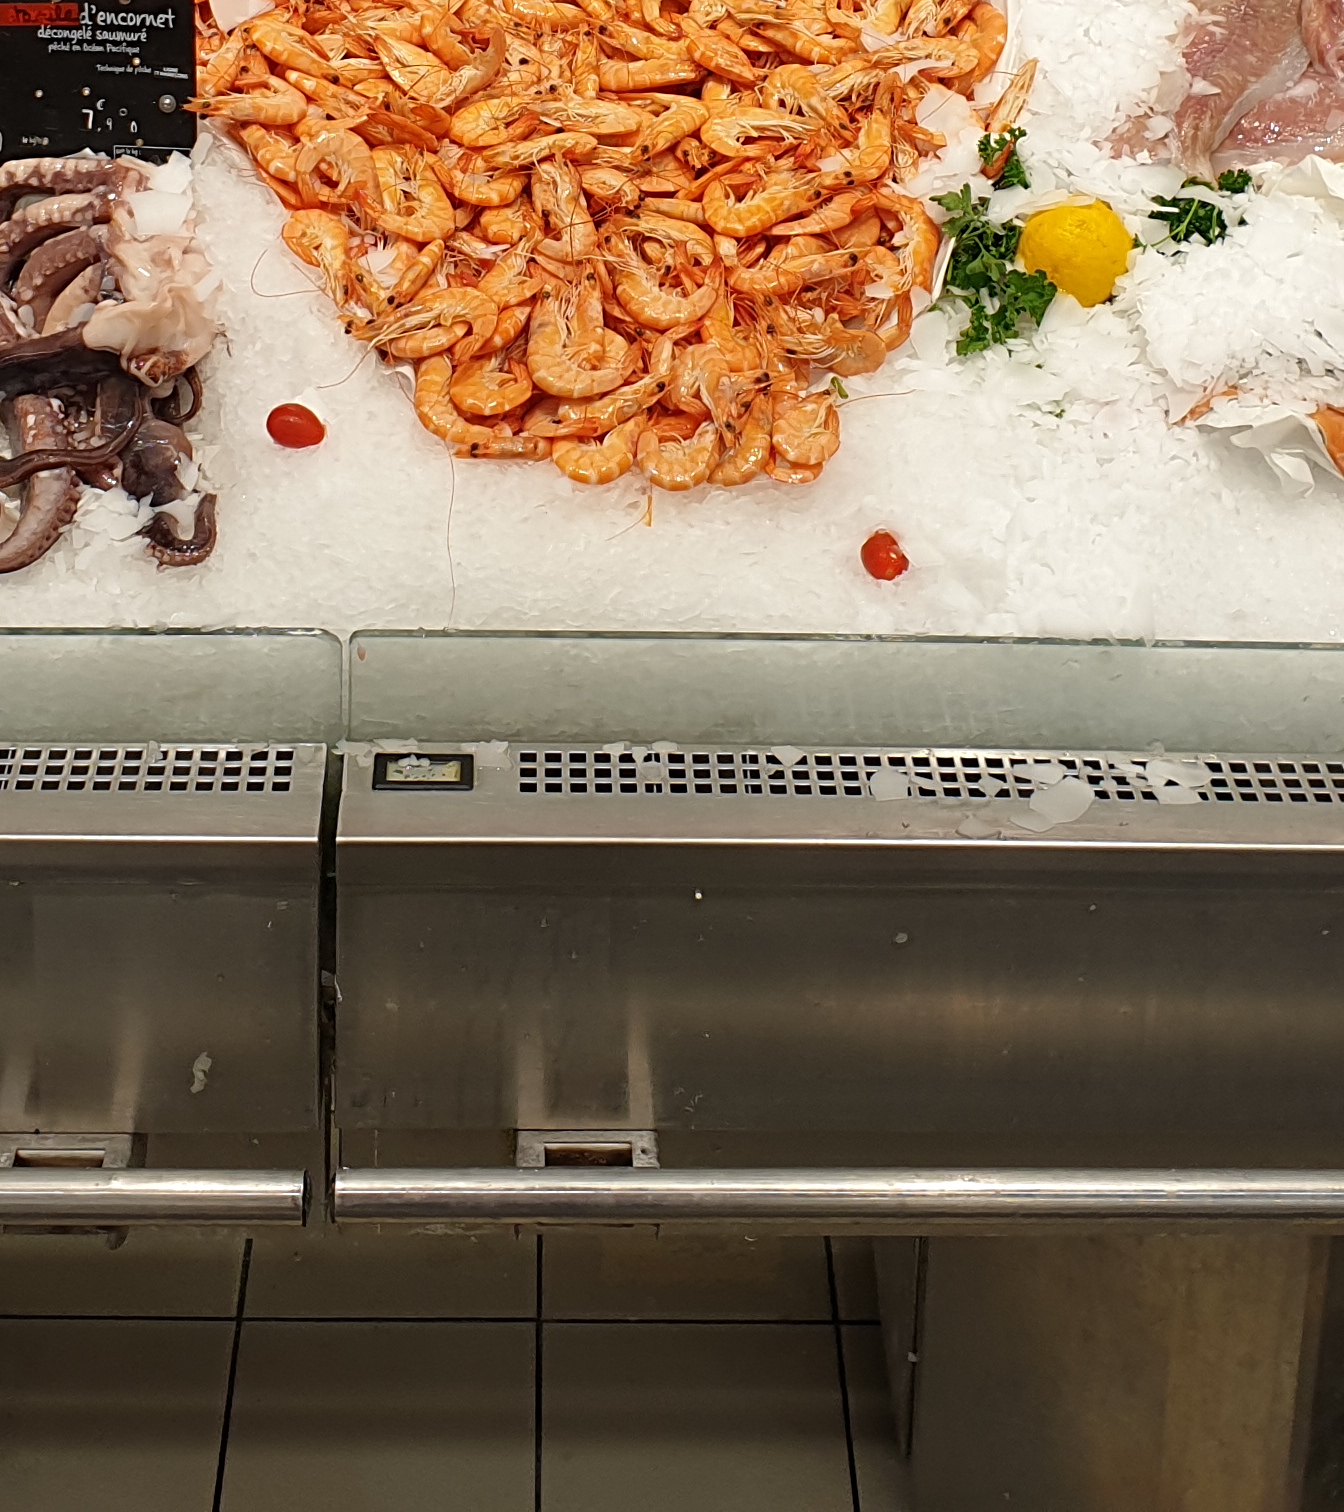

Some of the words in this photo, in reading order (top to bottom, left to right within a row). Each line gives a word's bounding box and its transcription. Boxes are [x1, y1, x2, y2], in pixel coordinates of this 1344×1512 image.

[79, 2, 176, 29] d'encornet
[37, 24, 92, 44] décongelé
[95, 28, 148, 43] saumuré
[48, 42, 71, 54] pêché
[71, 43, 82, 53] en
[106, 42, 141, 56] Pacifique
